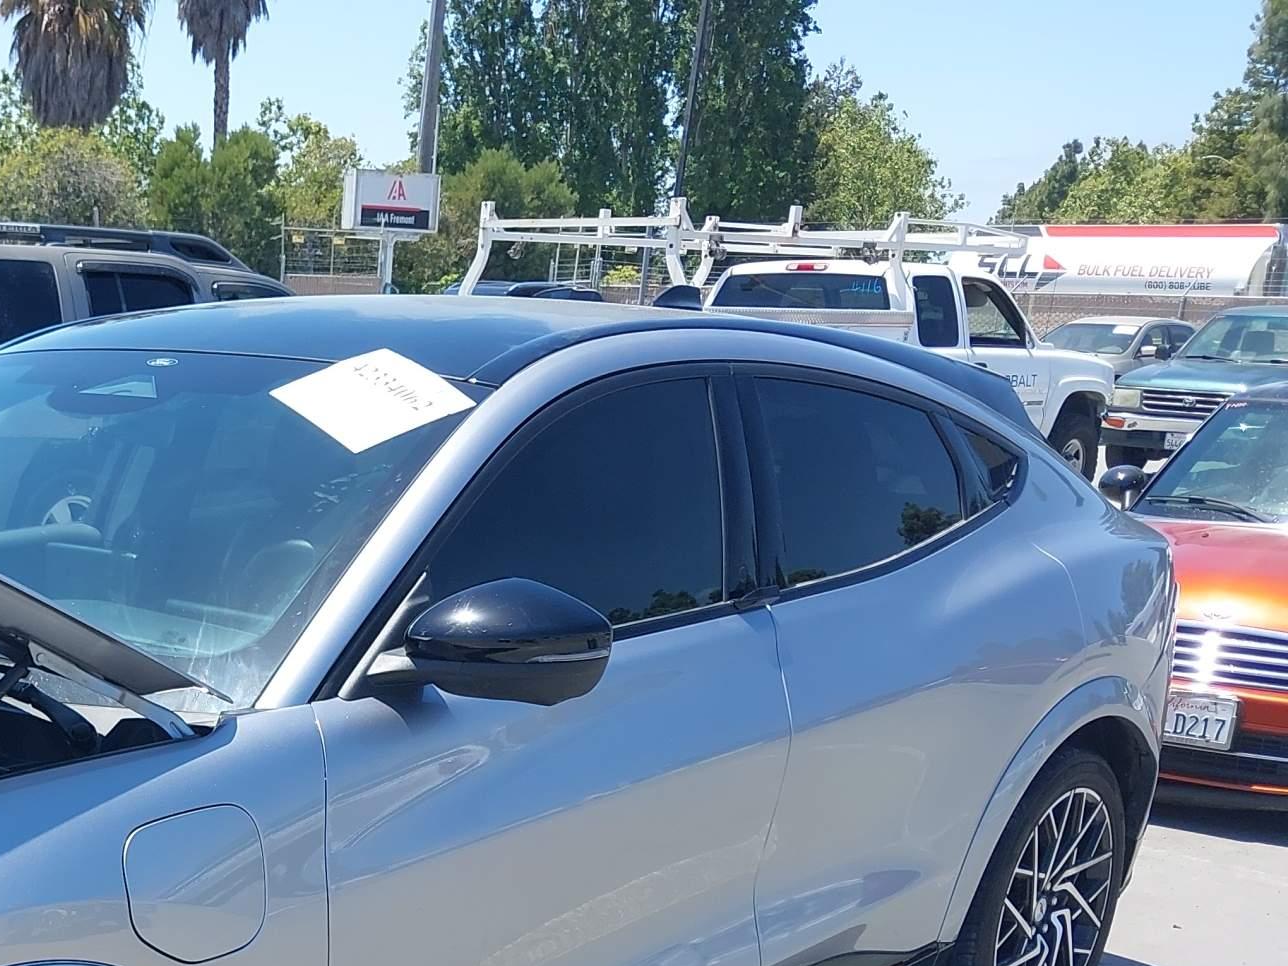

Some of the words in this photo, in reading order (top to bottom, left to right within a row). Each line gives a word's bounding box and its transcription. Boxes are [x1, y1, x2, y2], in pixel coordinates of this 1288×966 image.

[389, 213, 415, 225] Fremont
[1077, 264, 1111, 277] BULK
[1113, 264, 1145, 278] FUEL
[1148, 265, 1214, 279] DELIVERY
[1006, 373, 1039, 388] BALT
[1164, 713, 1227, 741] D217
